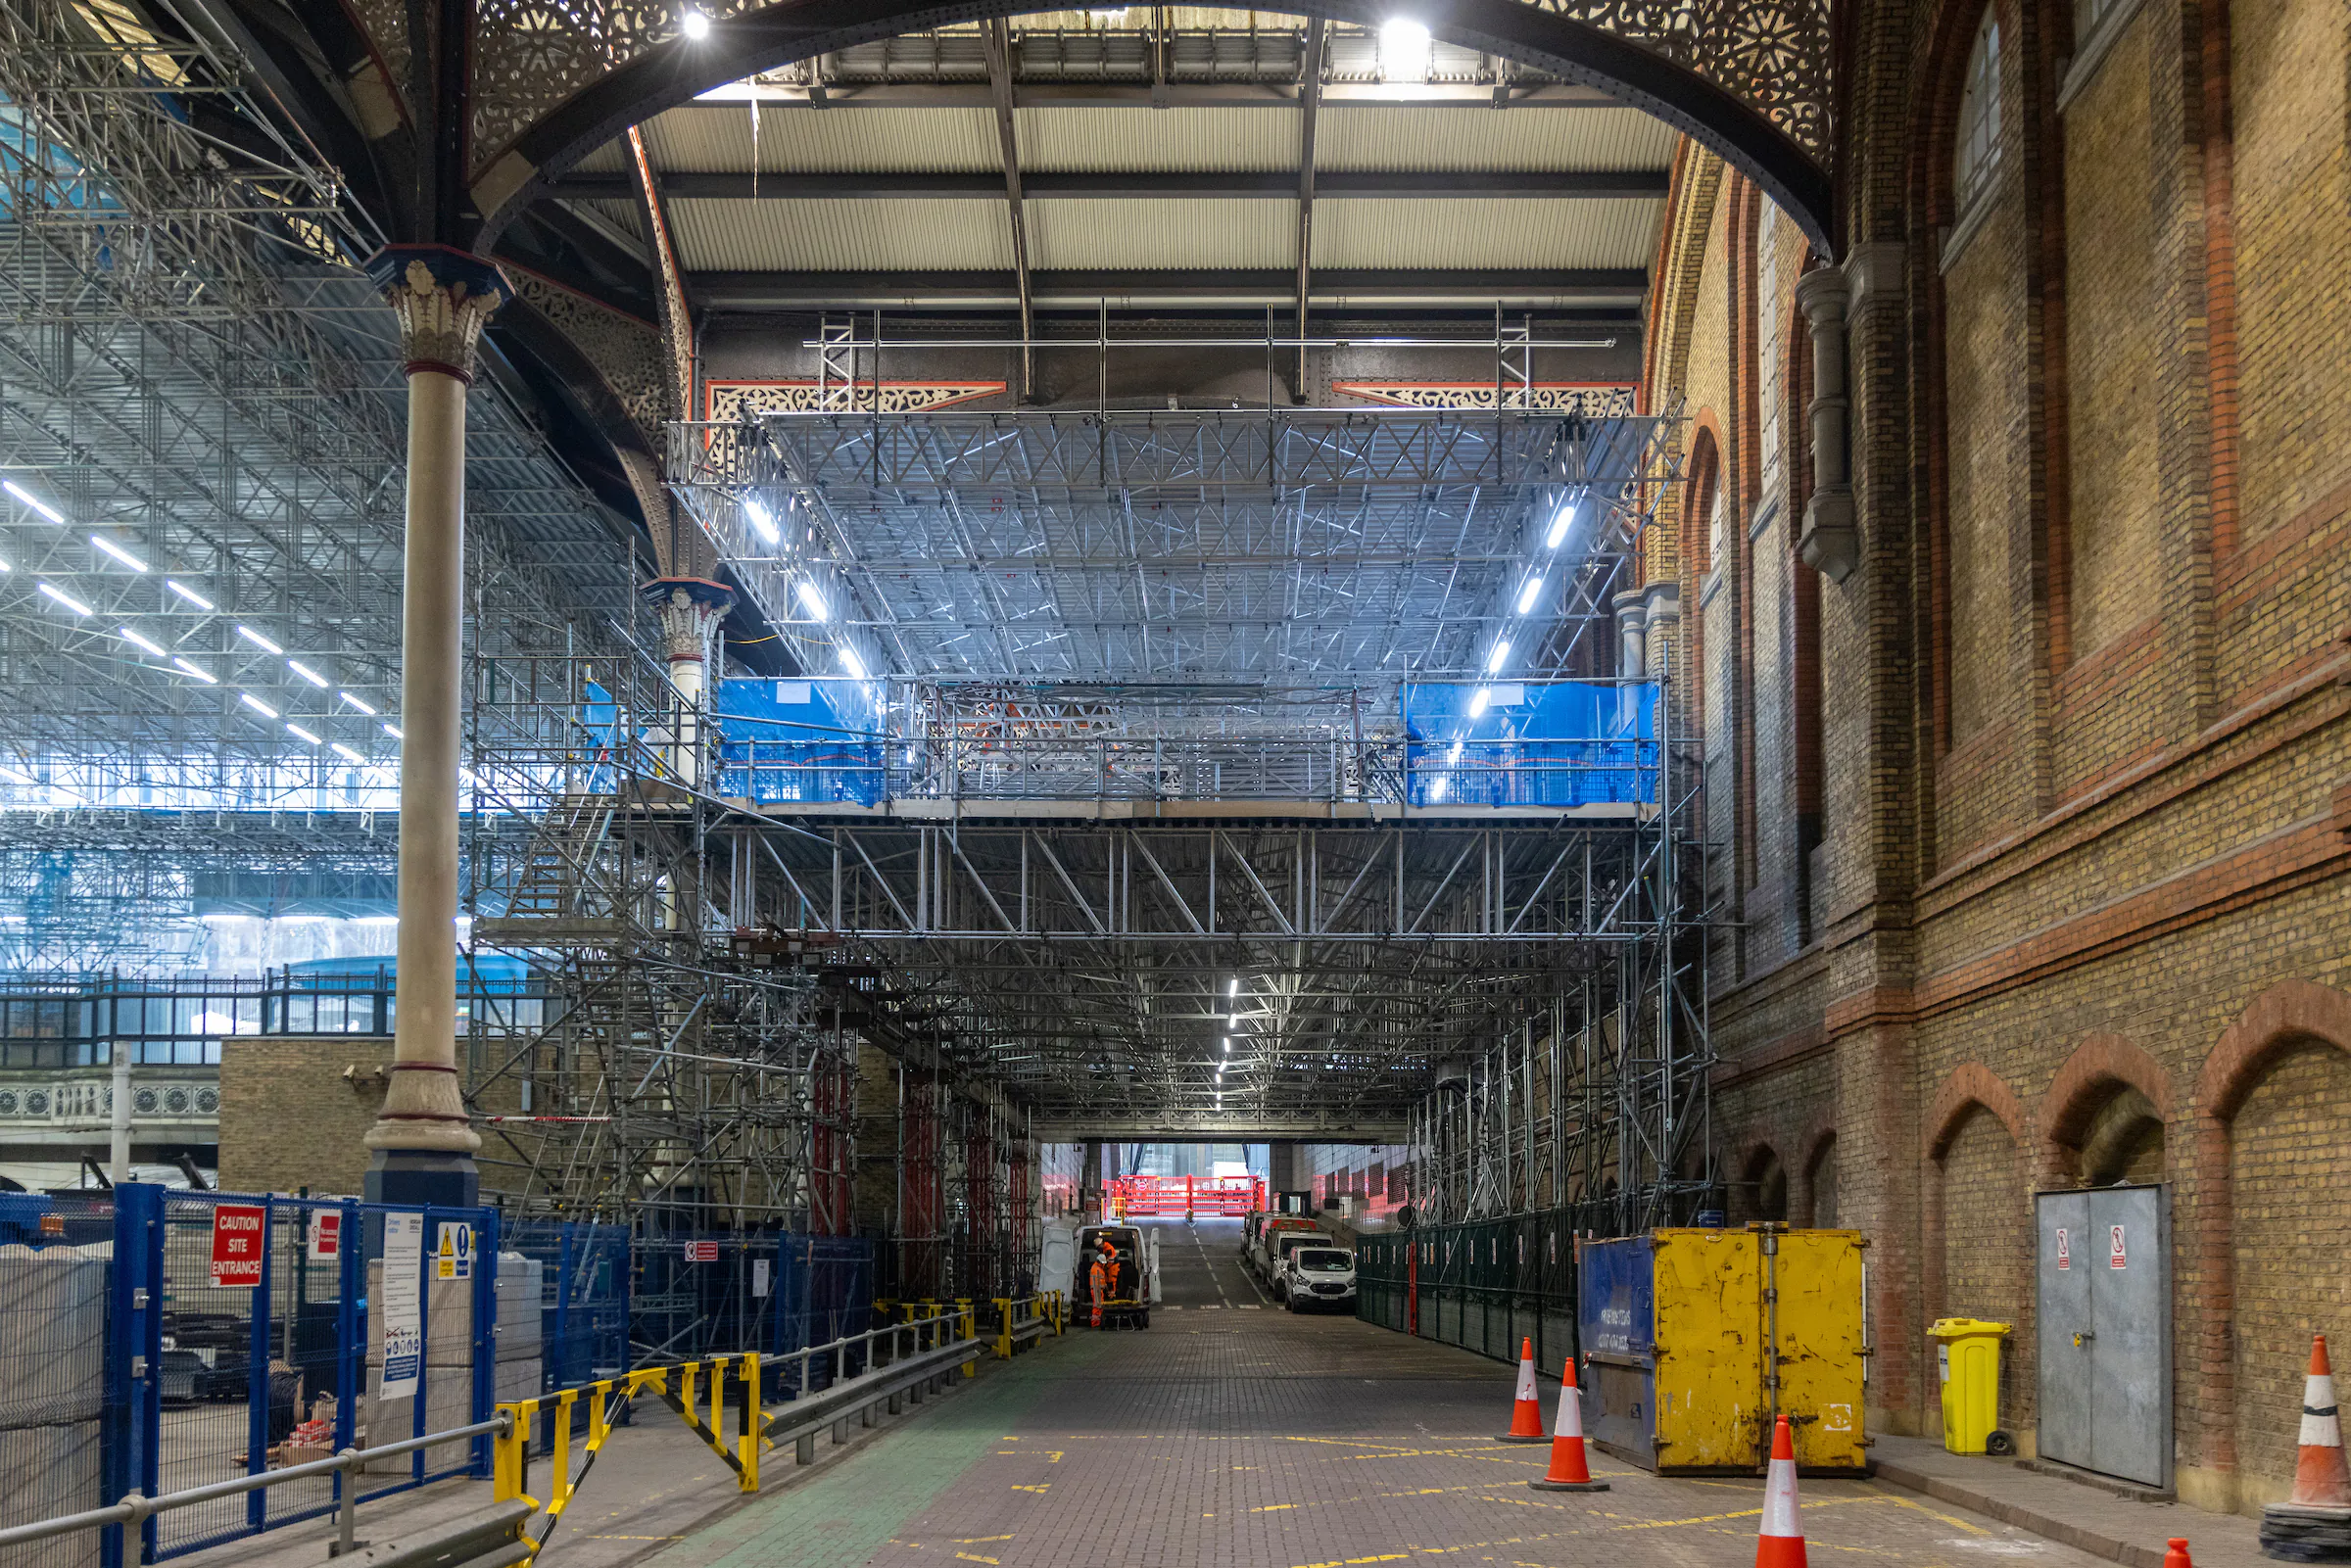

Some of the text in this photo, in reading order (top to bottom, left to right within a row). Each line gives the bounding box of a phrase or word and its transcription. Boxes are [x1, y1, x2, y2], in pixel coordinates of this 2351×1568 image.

[219, 1215, 260, 1230] CAUTION
[227, 1238, 248, 1253] SITE
[213, 1260, 261, 1275] ENTRANCE
